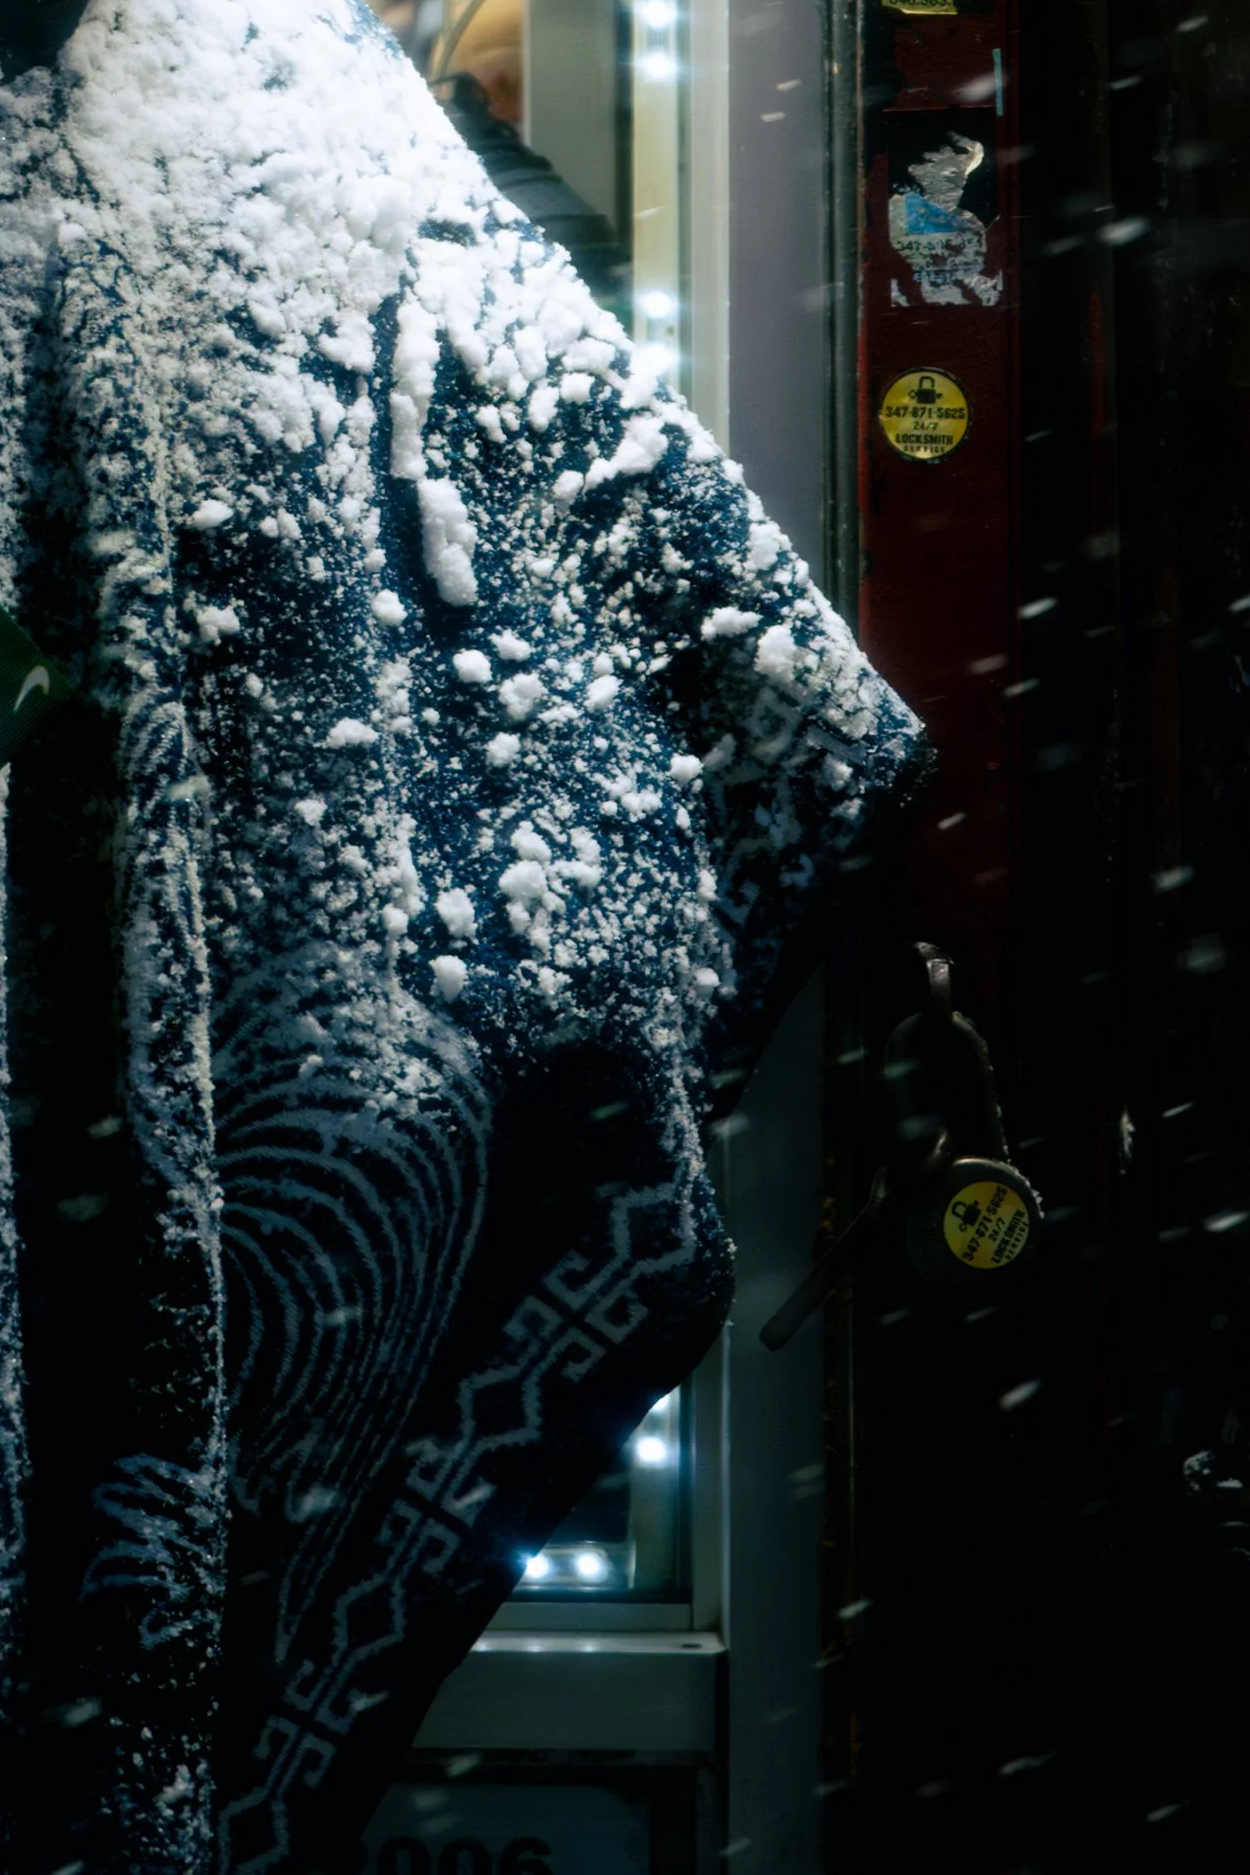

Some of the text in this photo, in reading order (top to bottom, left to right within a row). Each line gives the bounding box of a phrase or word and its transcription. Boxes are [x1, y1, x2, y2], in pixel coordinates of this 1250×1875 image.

[913, 421, 939, 430] 24/7
[895, 433, 954, 445] LOCKSMITH
[990, 1209, 1025, 1264] LOCKSMITH
